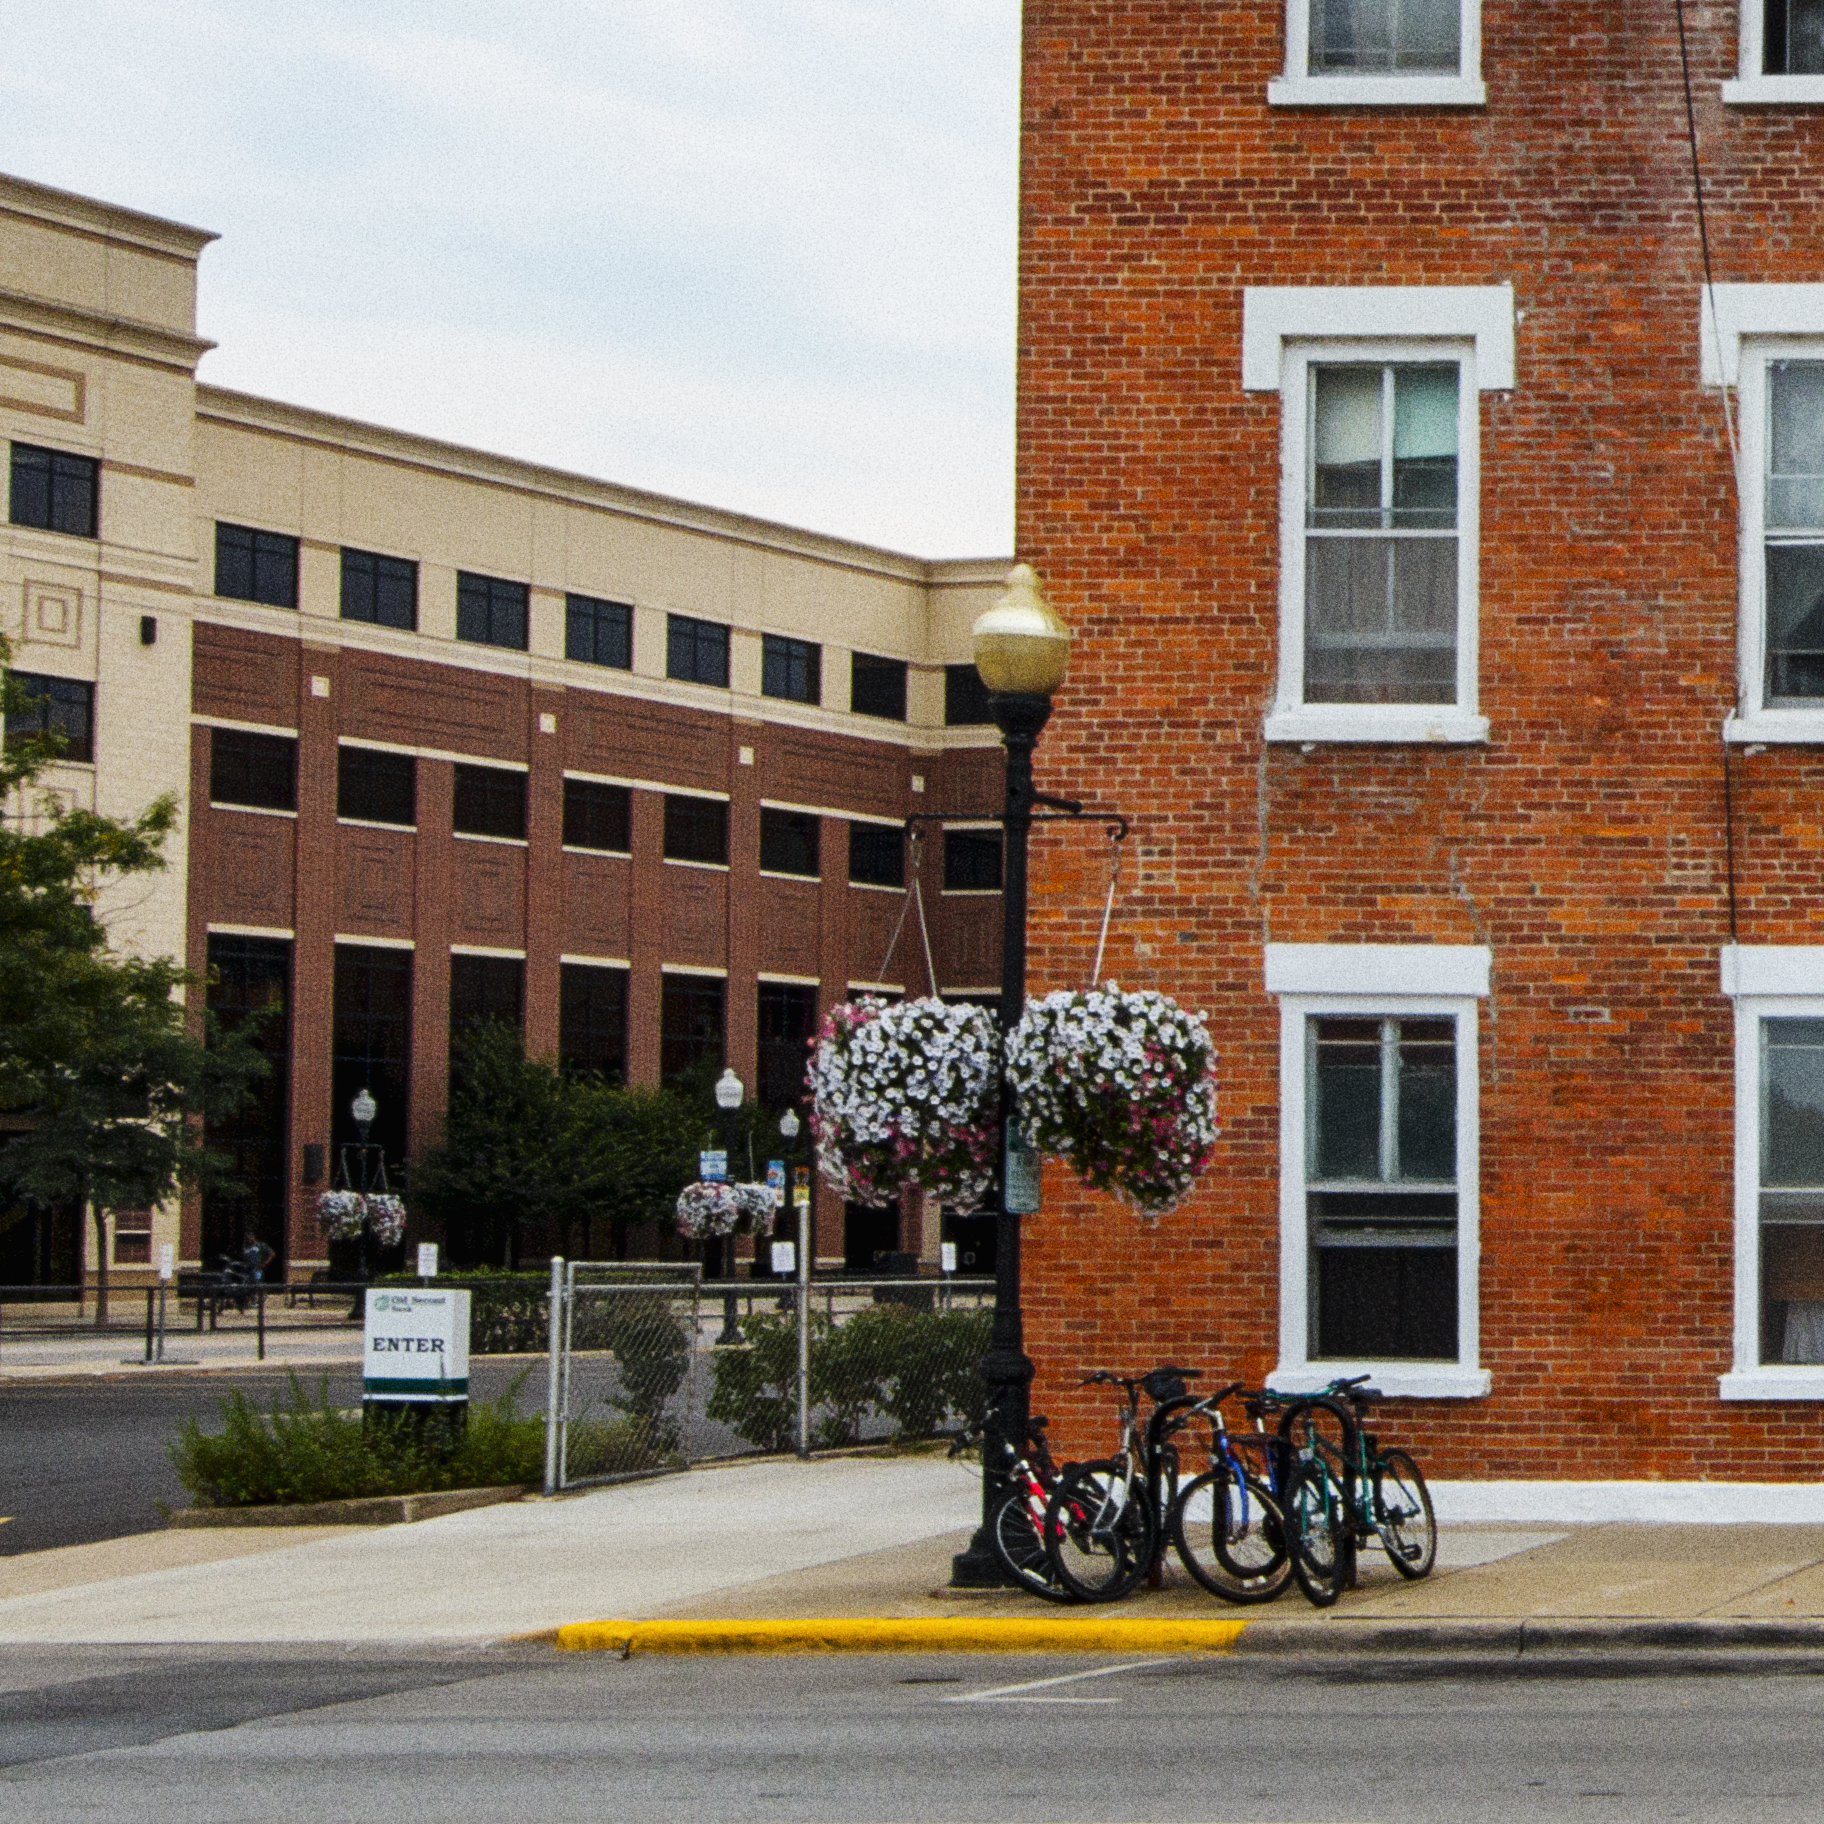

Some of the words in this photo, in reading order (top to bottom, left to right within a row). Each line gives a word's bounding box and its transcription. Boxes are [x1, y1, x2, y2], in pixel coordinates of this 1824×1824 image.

[391, 1295, 408, 1304] Old
[412, 1296, 446, 1304] Second
[372, 1337, 445, 1353] ENTER
